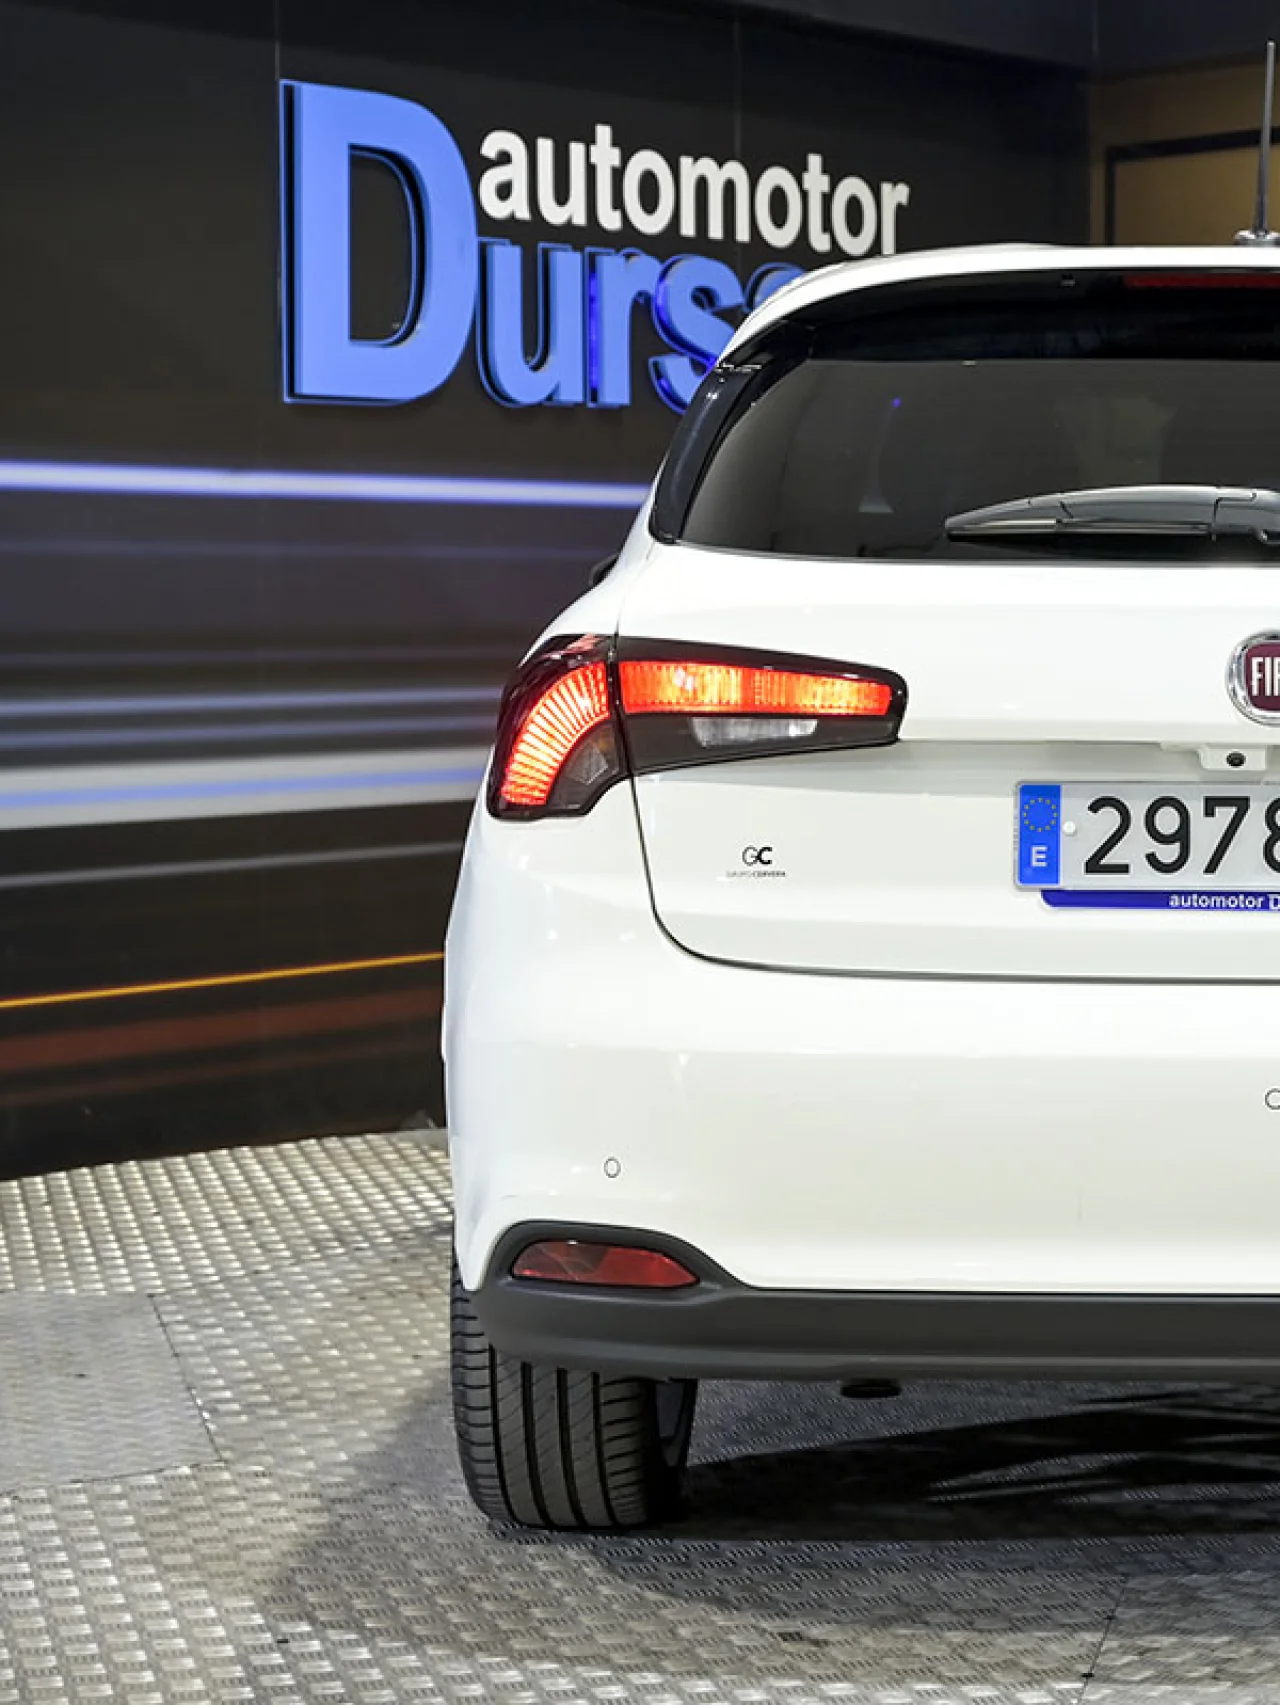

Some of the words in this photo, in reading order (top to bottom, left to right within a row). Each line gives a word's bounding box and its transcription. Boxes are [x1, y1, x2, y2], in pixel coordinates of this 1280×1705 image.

[478, 123, 910, 255] automotor
[279, 79, 804, 415] Durs
[1031, 845, 1049, 867] E
[1168, 893, 1265, 909] automotor
